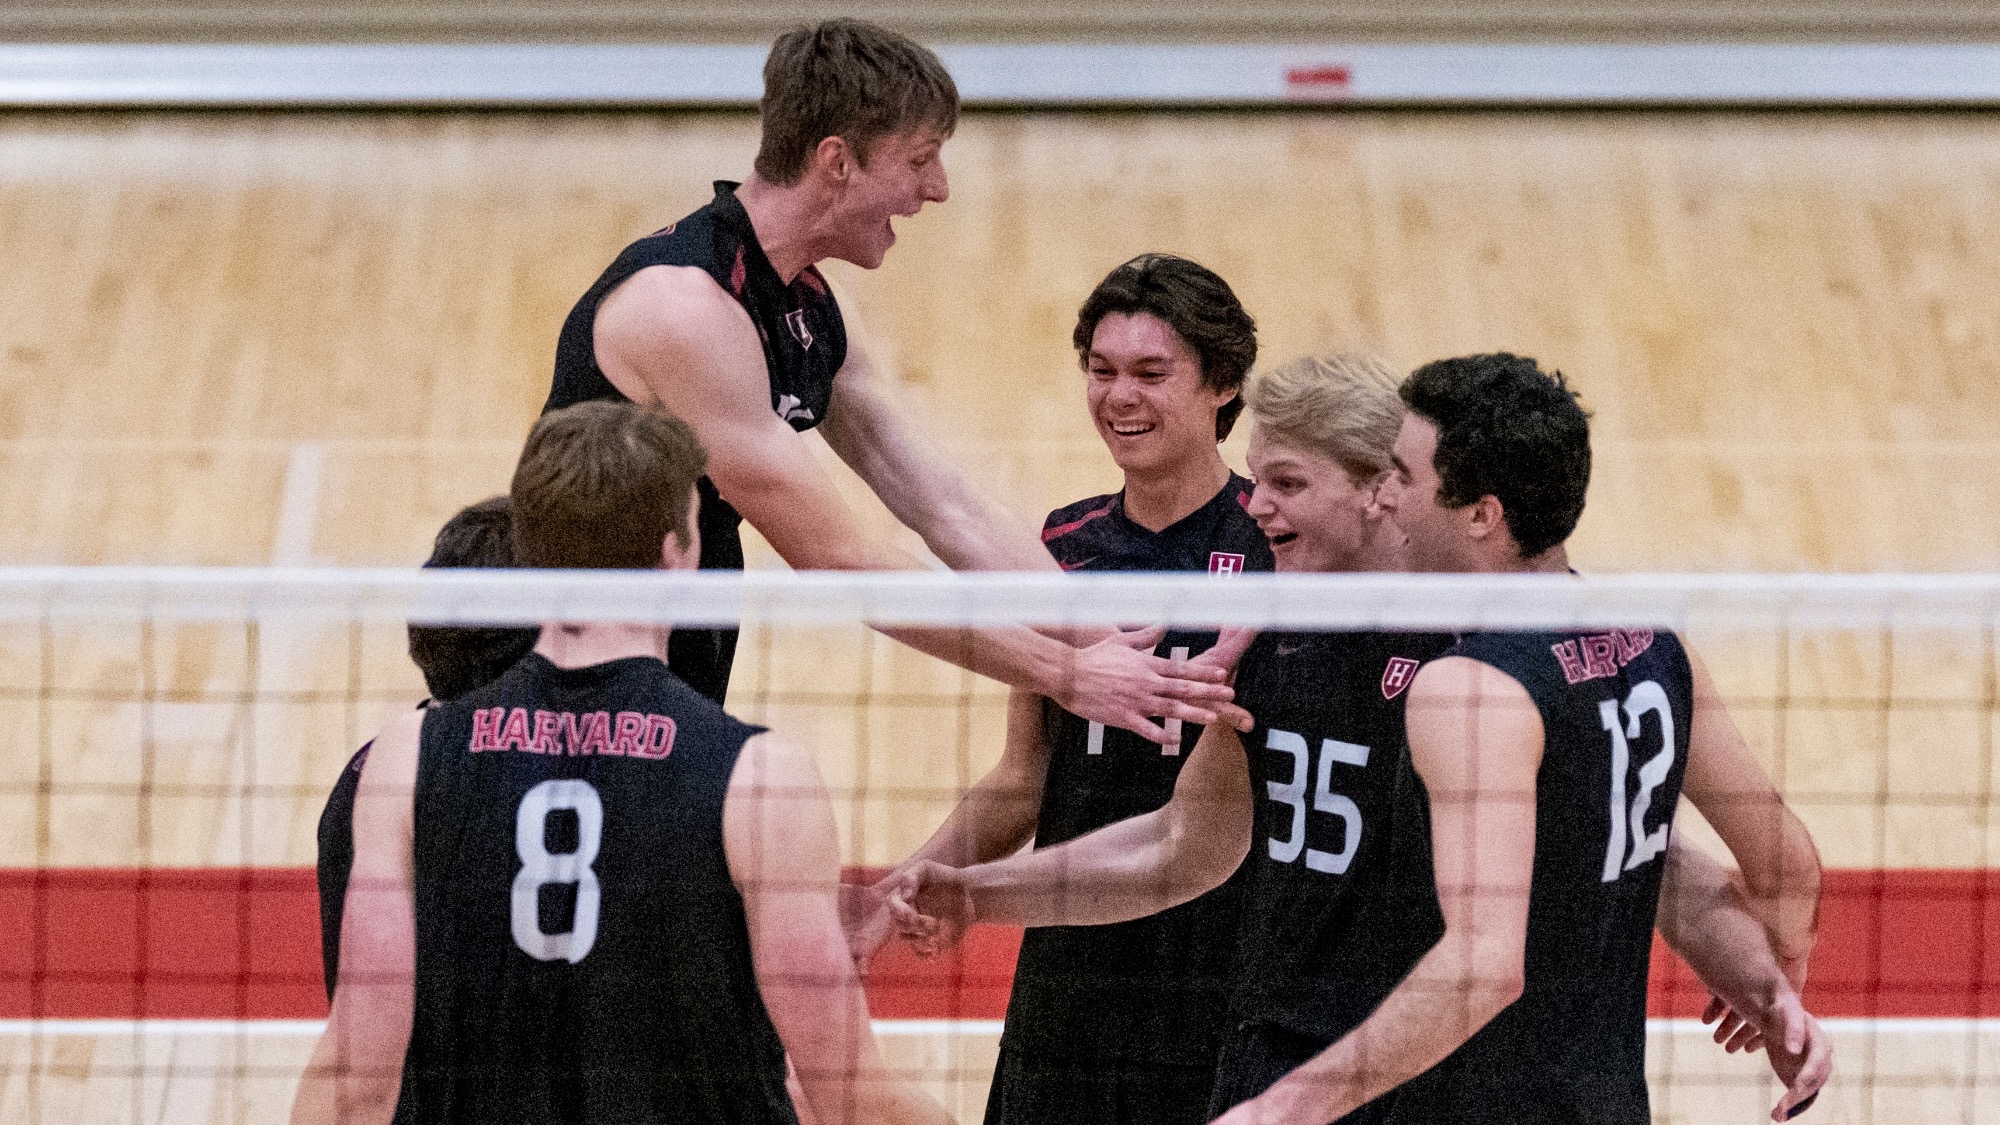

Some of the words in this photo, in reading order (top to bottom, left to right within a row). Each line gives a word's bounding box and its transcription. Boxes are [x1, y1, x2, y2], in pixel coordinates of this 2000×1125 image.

[1216, 557, 1236, 580] H
[1386, 662, 1411, 688] H
[468, 706, 677, 760] HARVARD
[1597, 679, 1675, 883] 12
[1265, 728, 1371, 875] 35
[510, 778, 603, 965] 8
